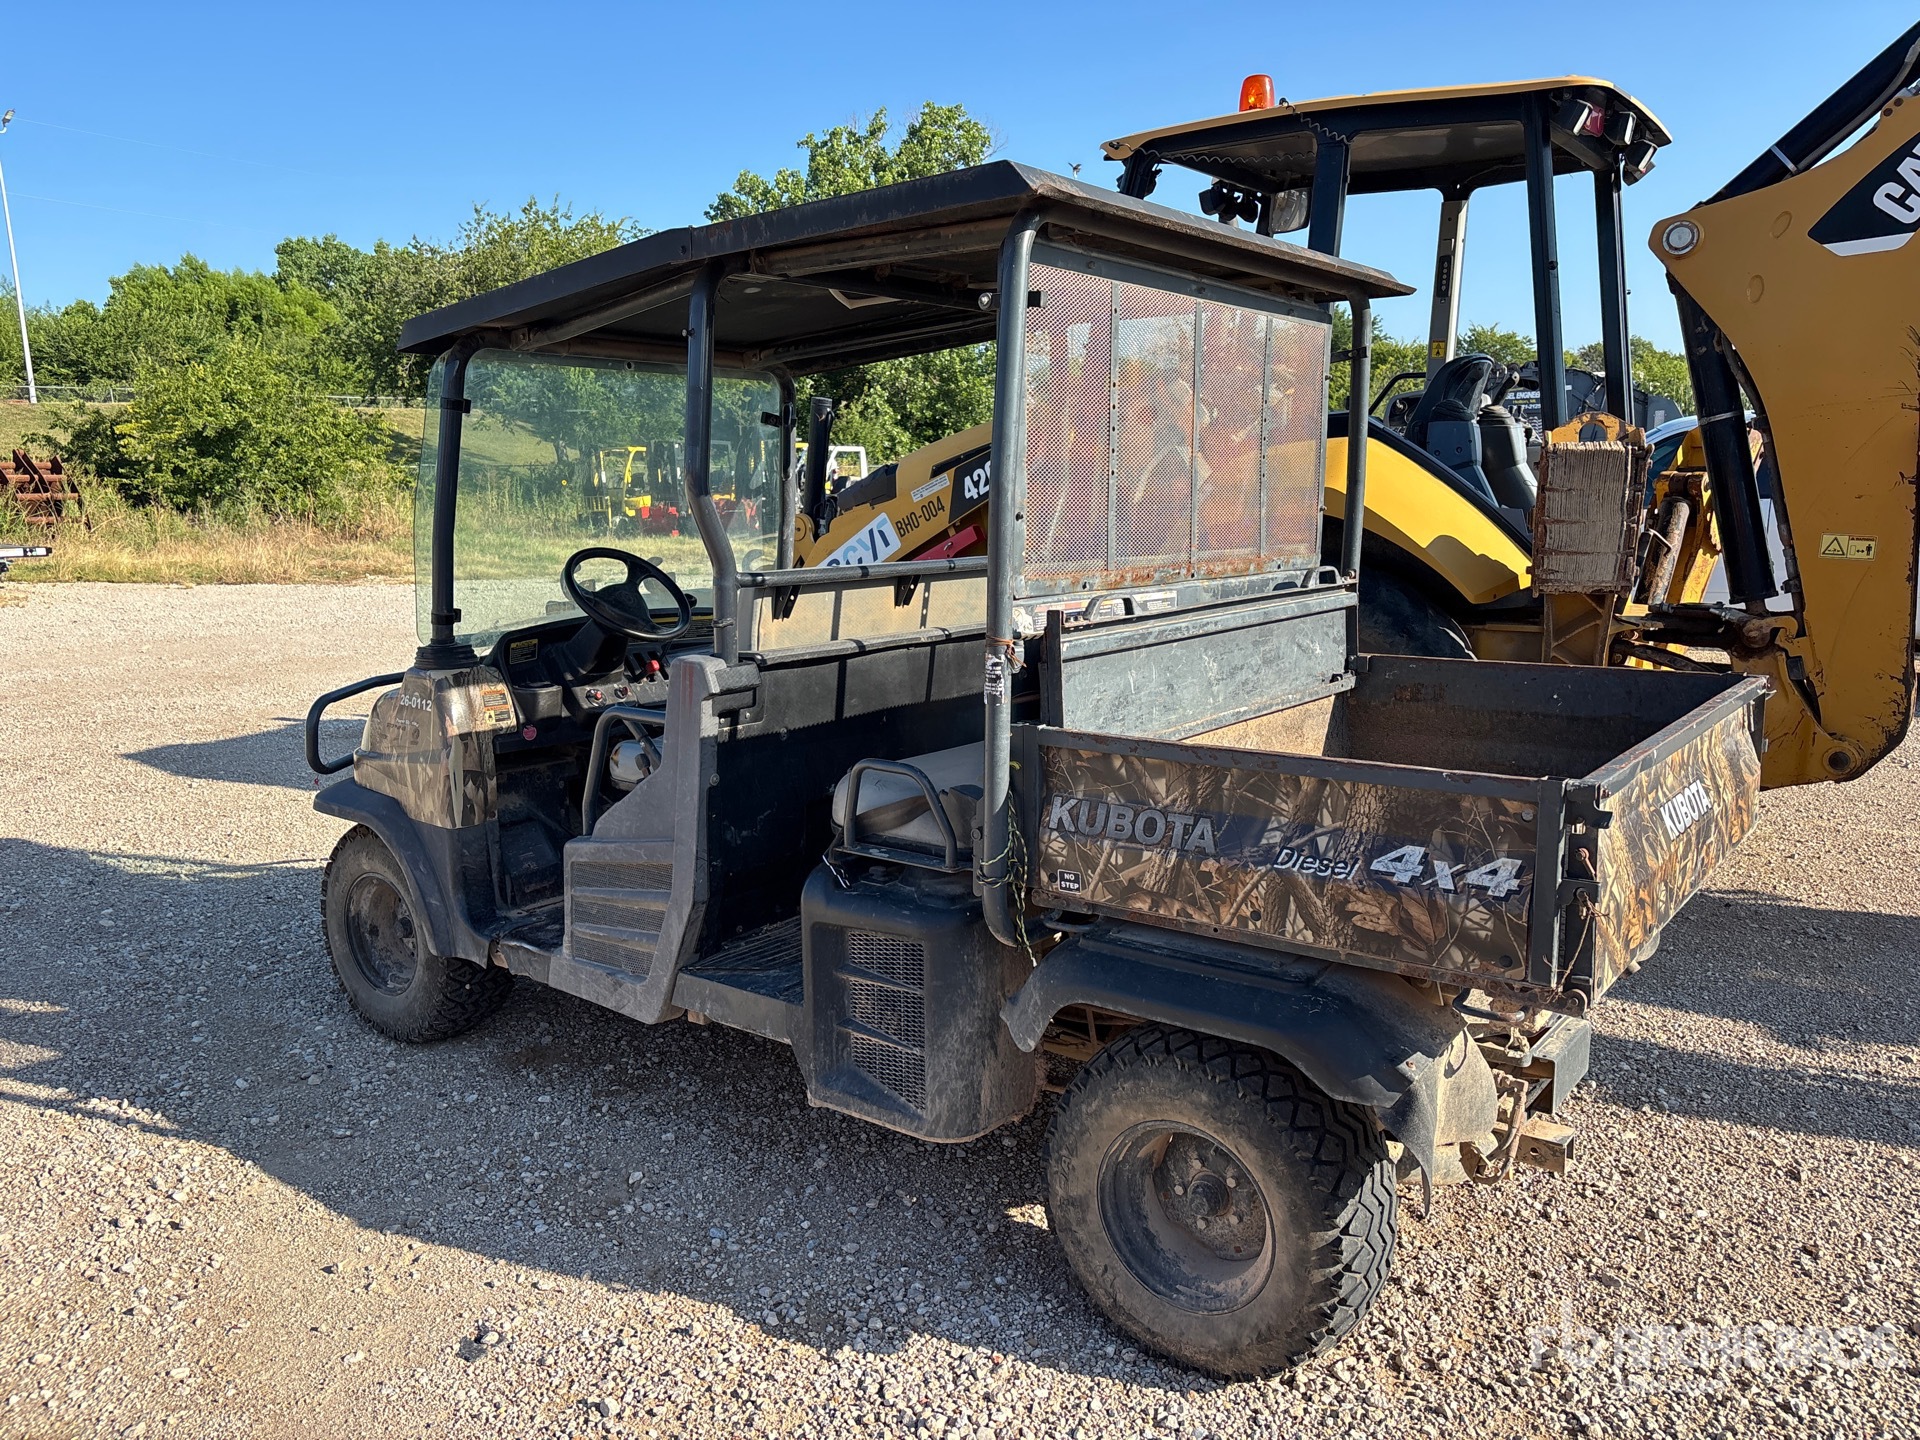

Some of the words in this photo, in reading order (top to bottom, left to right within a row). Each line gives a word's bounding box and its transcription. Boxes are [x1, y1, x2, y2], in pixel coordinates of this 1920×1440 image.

[400, 694, 432, 712] 26-0112
[1048, 795, 1218, 855] KUBOTA
[1660, 780, 1713, 841] KUBOTA
[1061, 881, 1079, 890] STEP
[1064, 873, 1075, 881] NO
[1273, 848, 1361, 880] Diesel
[1369, 845, 1524, 899] 4x4
